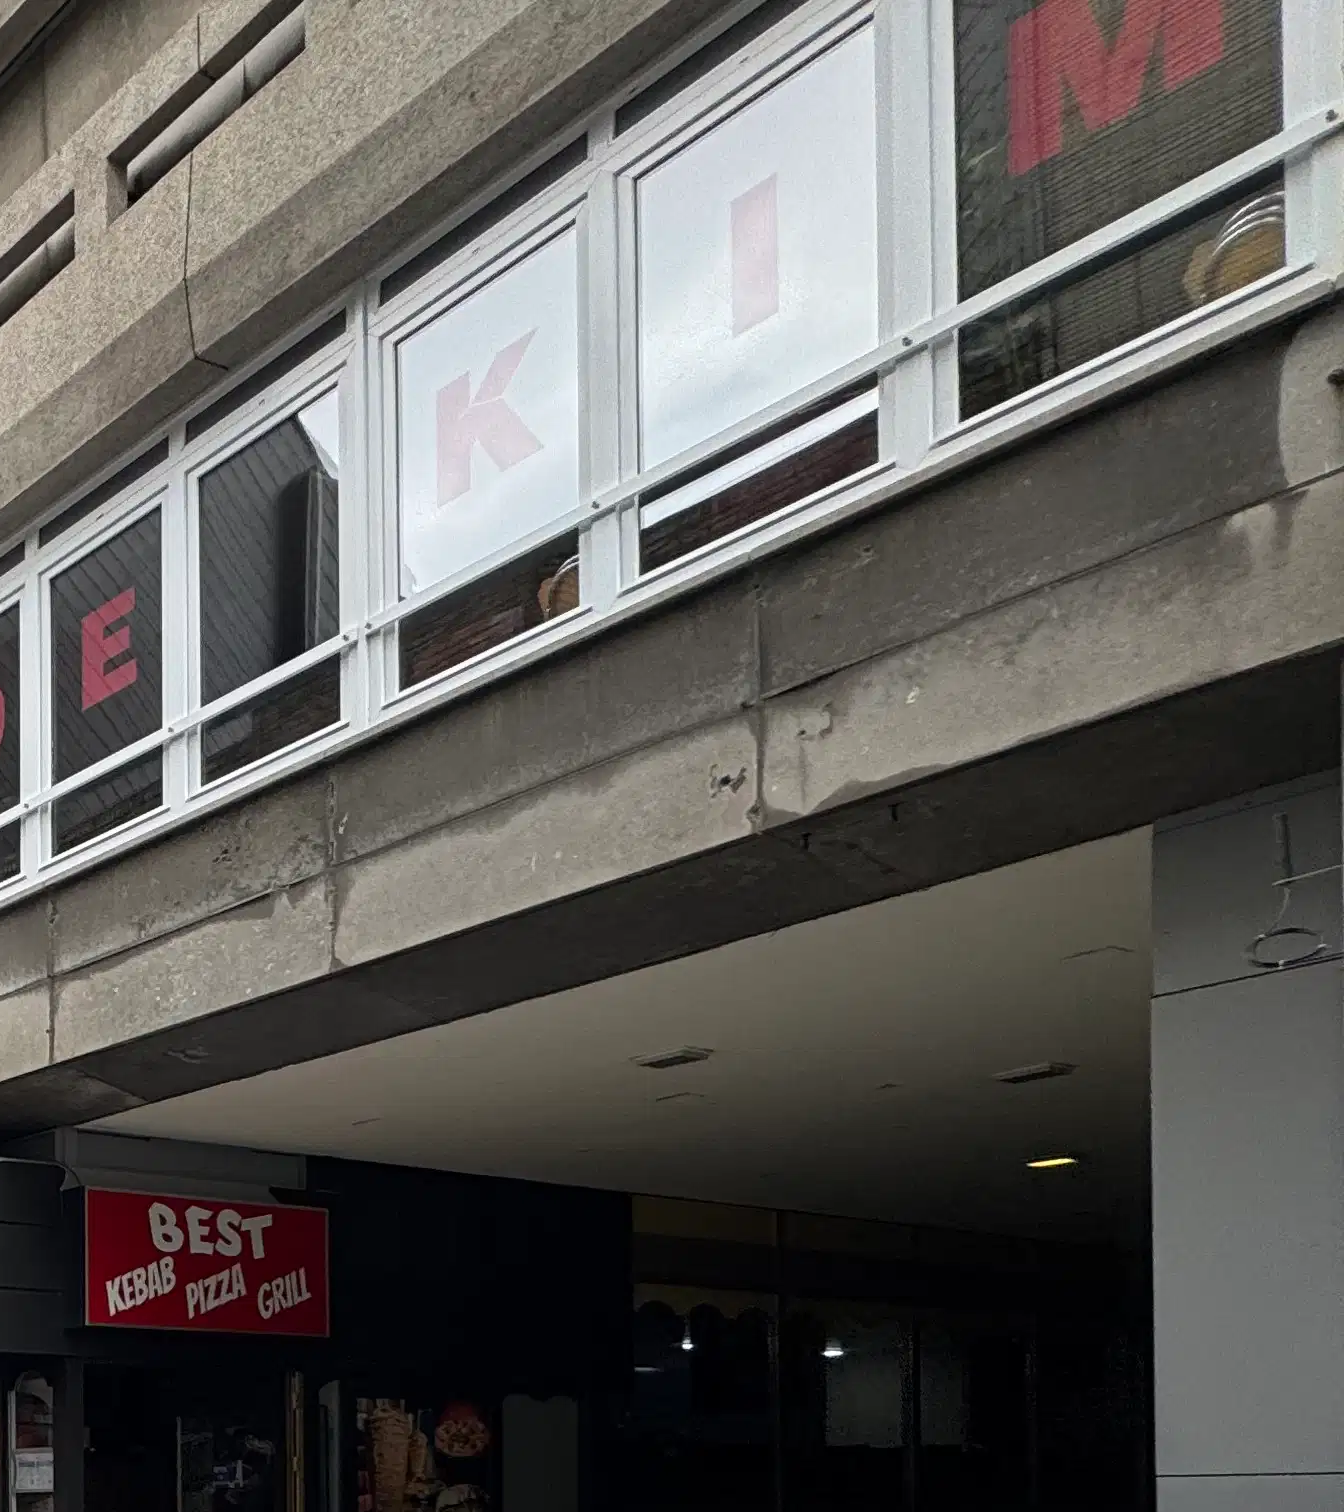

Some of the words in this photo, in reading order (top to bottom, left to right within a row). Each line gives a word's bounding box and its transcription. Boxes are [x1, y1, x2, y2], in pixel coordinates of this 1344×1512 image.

[148, 1201, 272, 1259] BEST
[105, 1256, 177, 1317] KEBAB
[185, 1262, 248, 1321] PIZZA
[257, 1266, 313, 1320] GRILL
